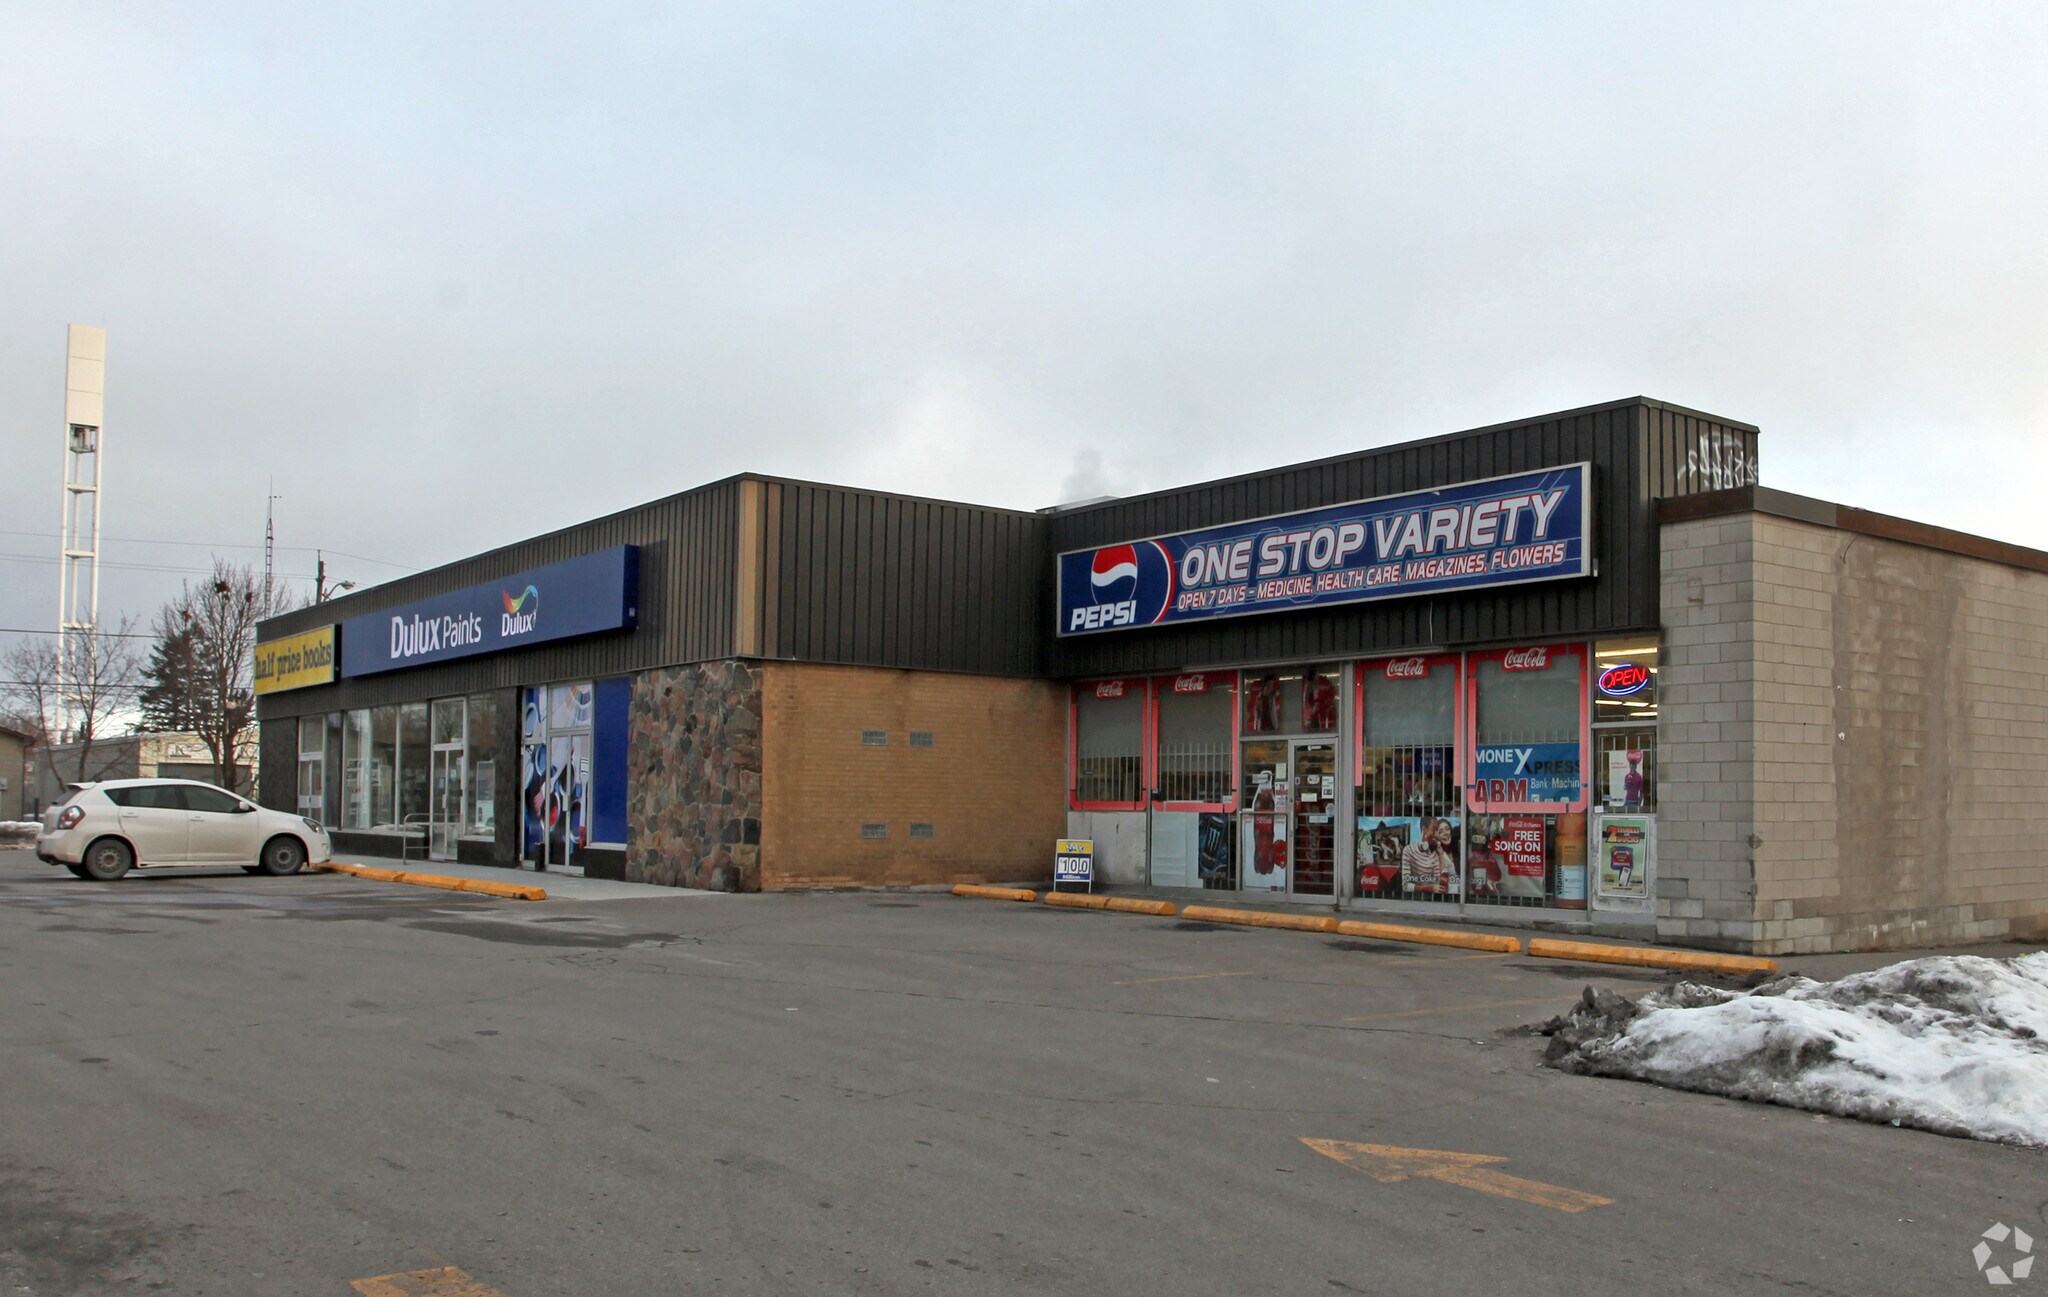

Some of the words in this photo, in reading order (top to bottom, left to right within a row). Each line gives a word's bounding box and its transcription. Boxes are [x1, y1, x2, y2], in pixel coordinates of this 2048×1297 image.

[1181, 540, 1252, 588] ONE
[1258, 523, 1365, 577] STOP
[1375, 488, 1567, 560] VARIETY
[1177, 593, 1207, 612] OPEN
[1209, 591, 1217, 607] 7
[1218, 586, 1246, 605] DAYS
[1256, 577, 1313, 600] MEDICINE,
[1316, 569, 1364, 592] HEALTH
[1366, 564, 1402, 586] CARE,
[1405, 553, 1488, 580] MAGAZINES,
[1491, 543, 1566, 569] FLOWERS
[501, 611, 533, 637] Dulux
[1070, 600, 1137, 631] PEPSI
[390, 614, 441, 659] Dulux
[442, 611, 482, 649] Paints
[255, 652, 275, 679] half
[277, 646, 301, 682] price
[303, 640, 331, 670] books
[1386, 657, 1425, 676] Coca-Cola
[1504, 647, 1548, 668] Coca-Cola
[1097, 681, 1123, 697] Coca-Cola
[1175, 674, 1204, 692] Coca-Cola
[1601, 668, 1648, 689] OPEN
[1474, 778, 1528, 802] ABM
[1530, 778, 1548, 789] Bank
[1551, 776, 1581, 788] Machin
[1514, 830, 1540, 841] FREE
[1494, 841, 1522, 852] SONG
[1524, 842, 1541, 852] ON
[1509, 852, 1541, 863] iTunes
[1405, 874, 1419, 882] One
[1420, 874, 1437, 883] Coke
